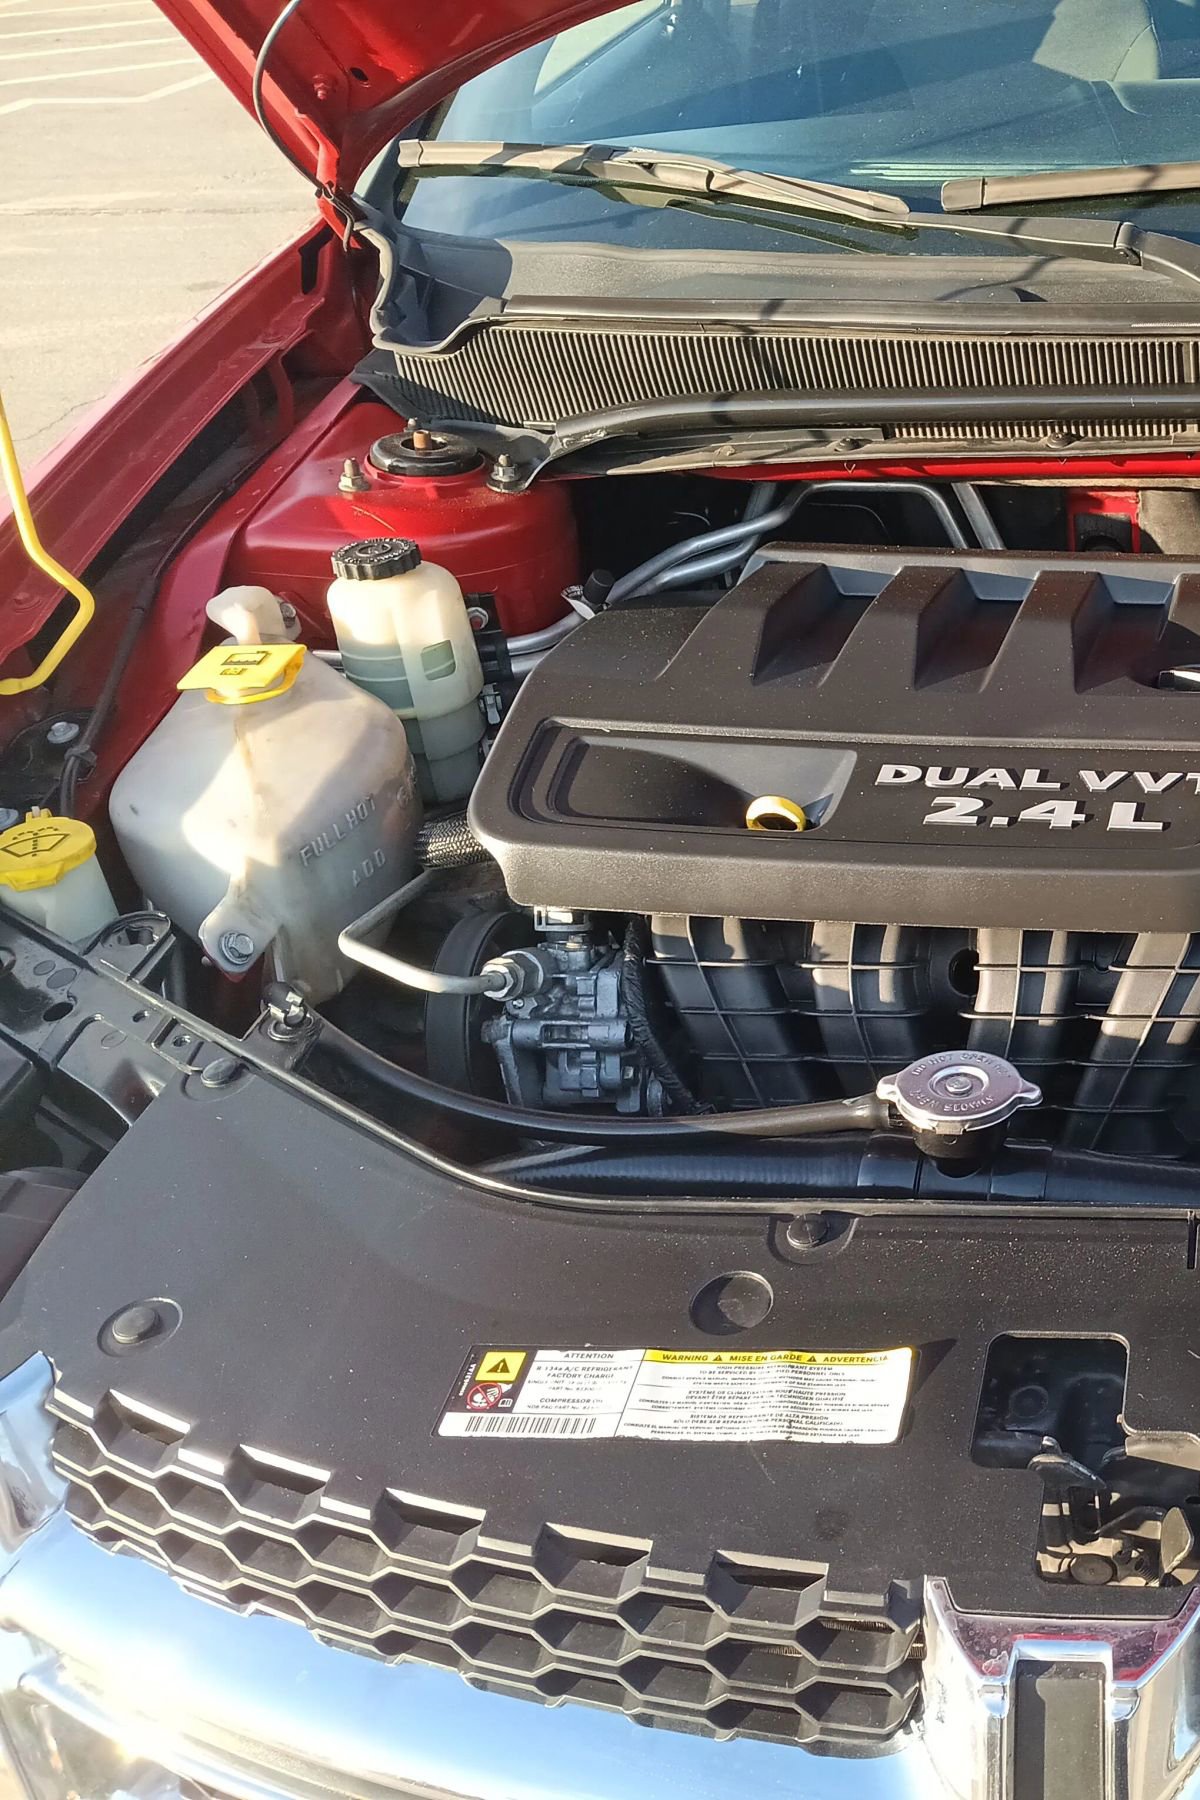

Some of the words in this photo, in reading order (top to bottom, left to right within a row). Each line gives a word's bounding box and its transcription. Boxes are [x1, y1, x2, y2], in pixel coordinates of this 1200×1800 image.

[875, 763, 1062, 791] DUAL
[300, 823, 346, 867] FULL
[345, 793, 377, 830] HOT
[922, 796, 1086, 830] 2.4
[1107, 802, 1164, 832] L
[351, 848, 387, 888] ADD
